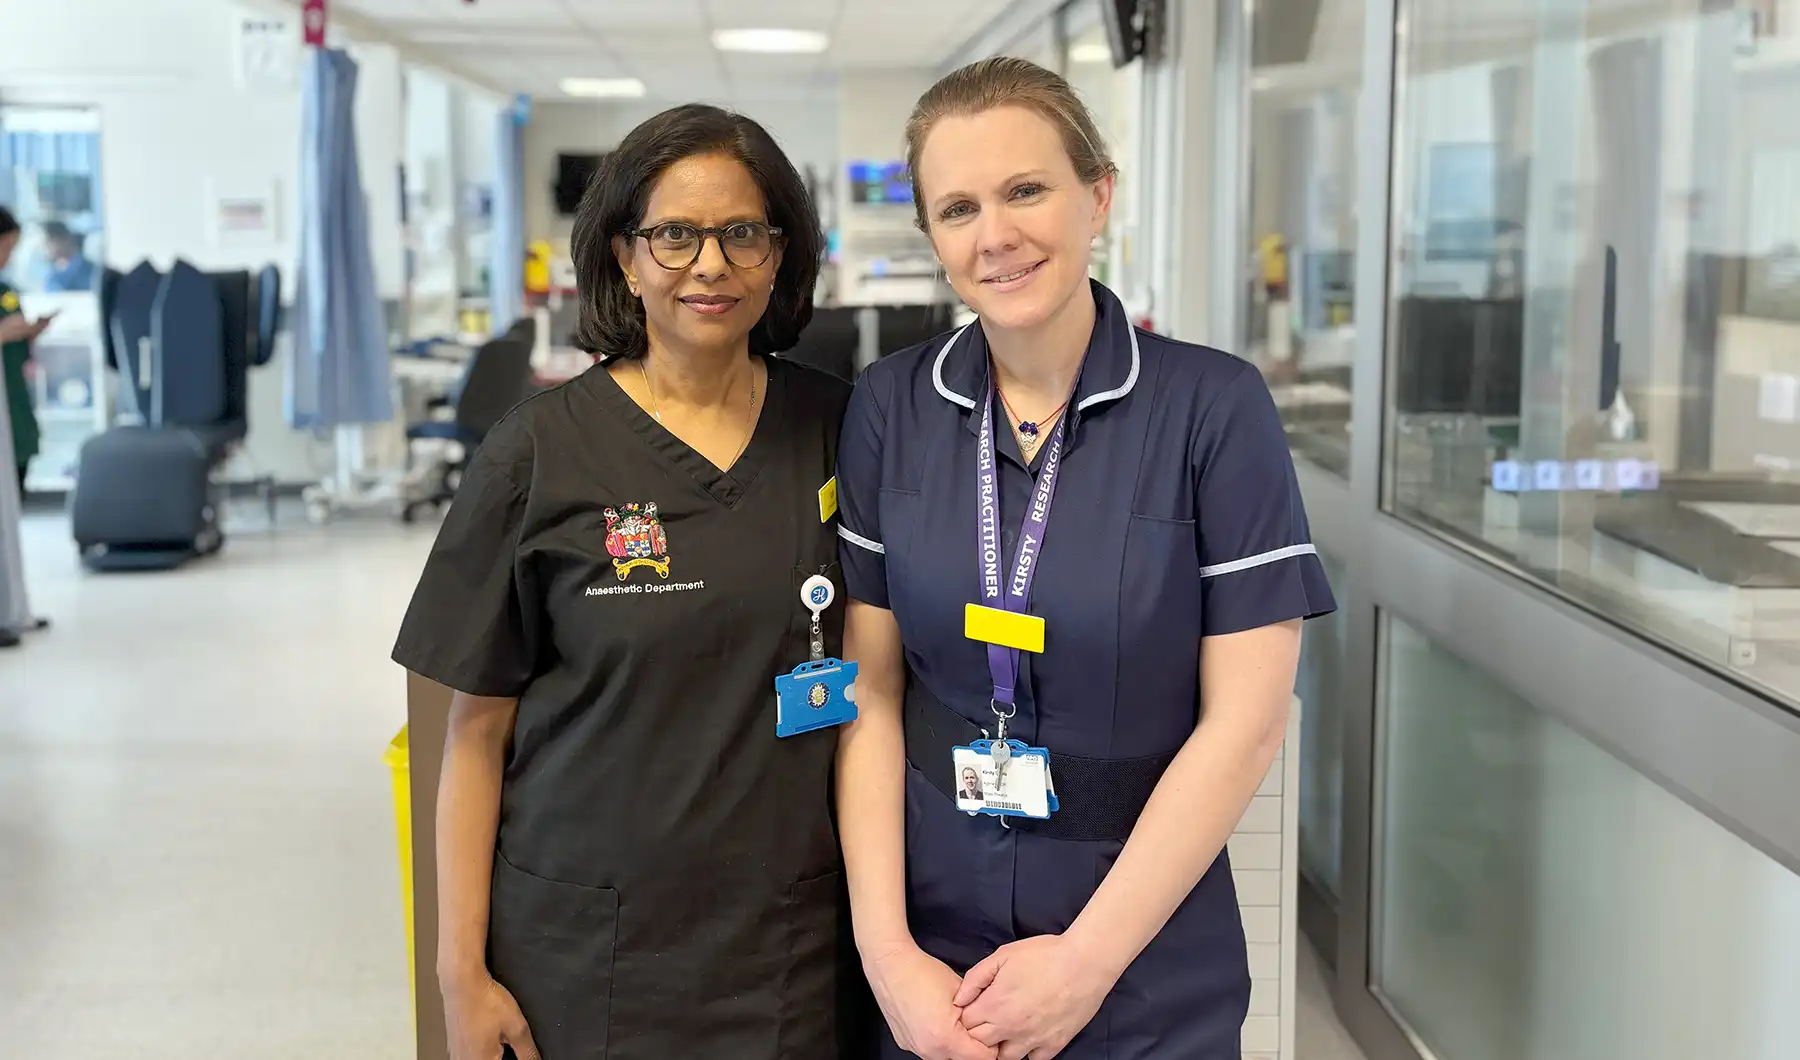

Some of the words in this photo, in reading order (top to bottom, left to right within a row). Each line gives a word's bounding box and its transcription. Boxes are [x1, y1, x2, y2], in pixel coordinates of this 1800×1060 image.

[981, 474, 998, 597] PRACTITIONER
[1012, 534, 1036, 596] KIRSTY
[1032, 441, 1060, 522] RESEARCH
[585, 584, 643, 596] Anaesthetic
[645, 580, 704, 594] Department
